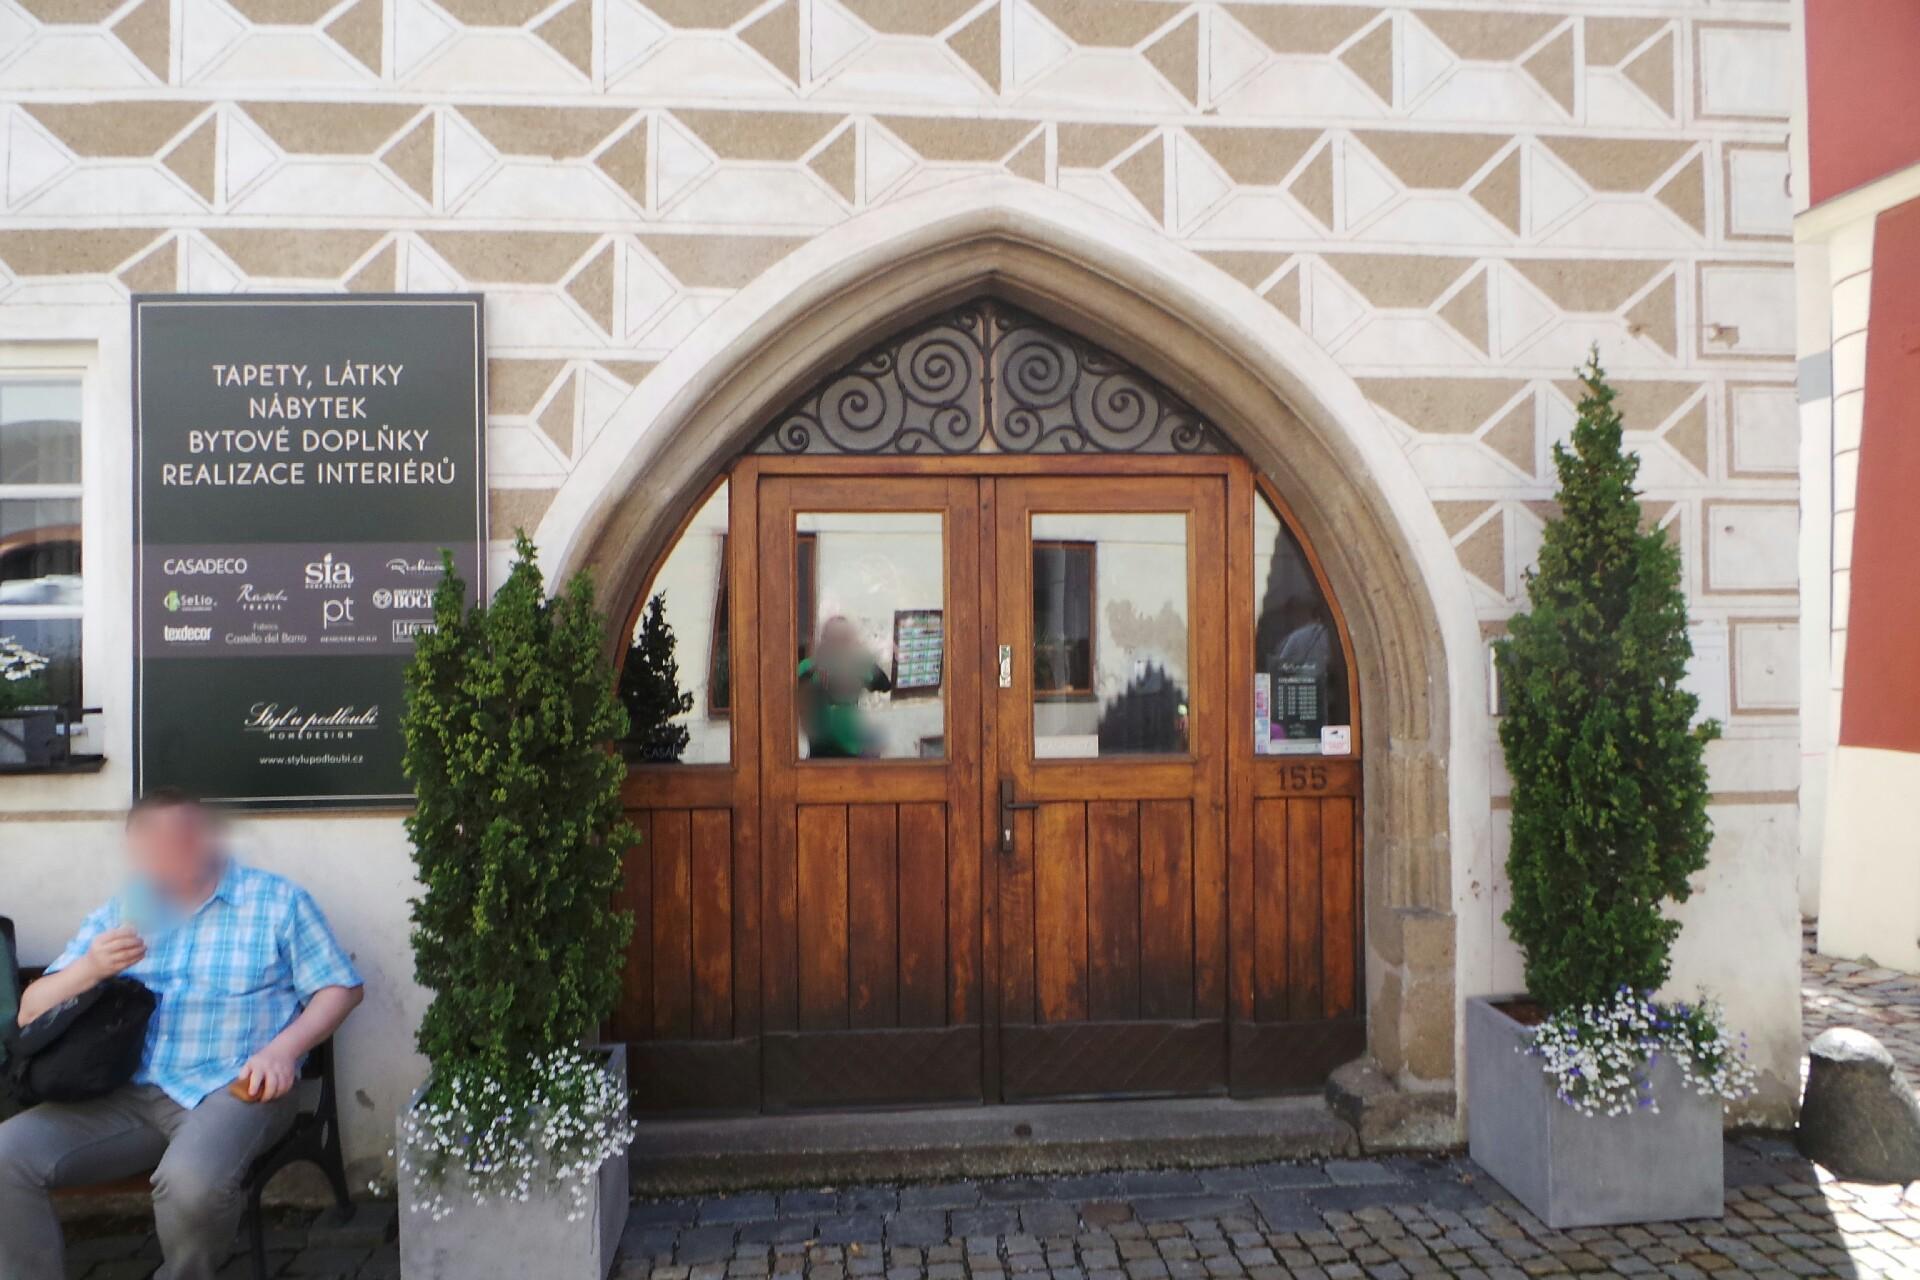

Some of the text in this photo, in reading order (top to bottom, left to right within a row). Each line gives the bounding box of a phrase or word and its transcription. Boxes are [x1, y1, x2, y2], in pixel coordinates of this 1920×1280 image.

[213, 360, 404, 389] TAPETY, LÁTKY
[249, 392, 367, 419] NÁBYTEK
[189, 424, 429, 453] BYTOVÉ DOPLŇKY
[162, 457, 456, 486] REALIZACE INTERIÉRŮ
[163, 558, 248, 575] CASADECO
[305, 552, 354, 584] sia
[323, 596, 354, 630] pt
[164, 625, 213, 642] texdecor
[1278, 764, 1329, 791] 155
